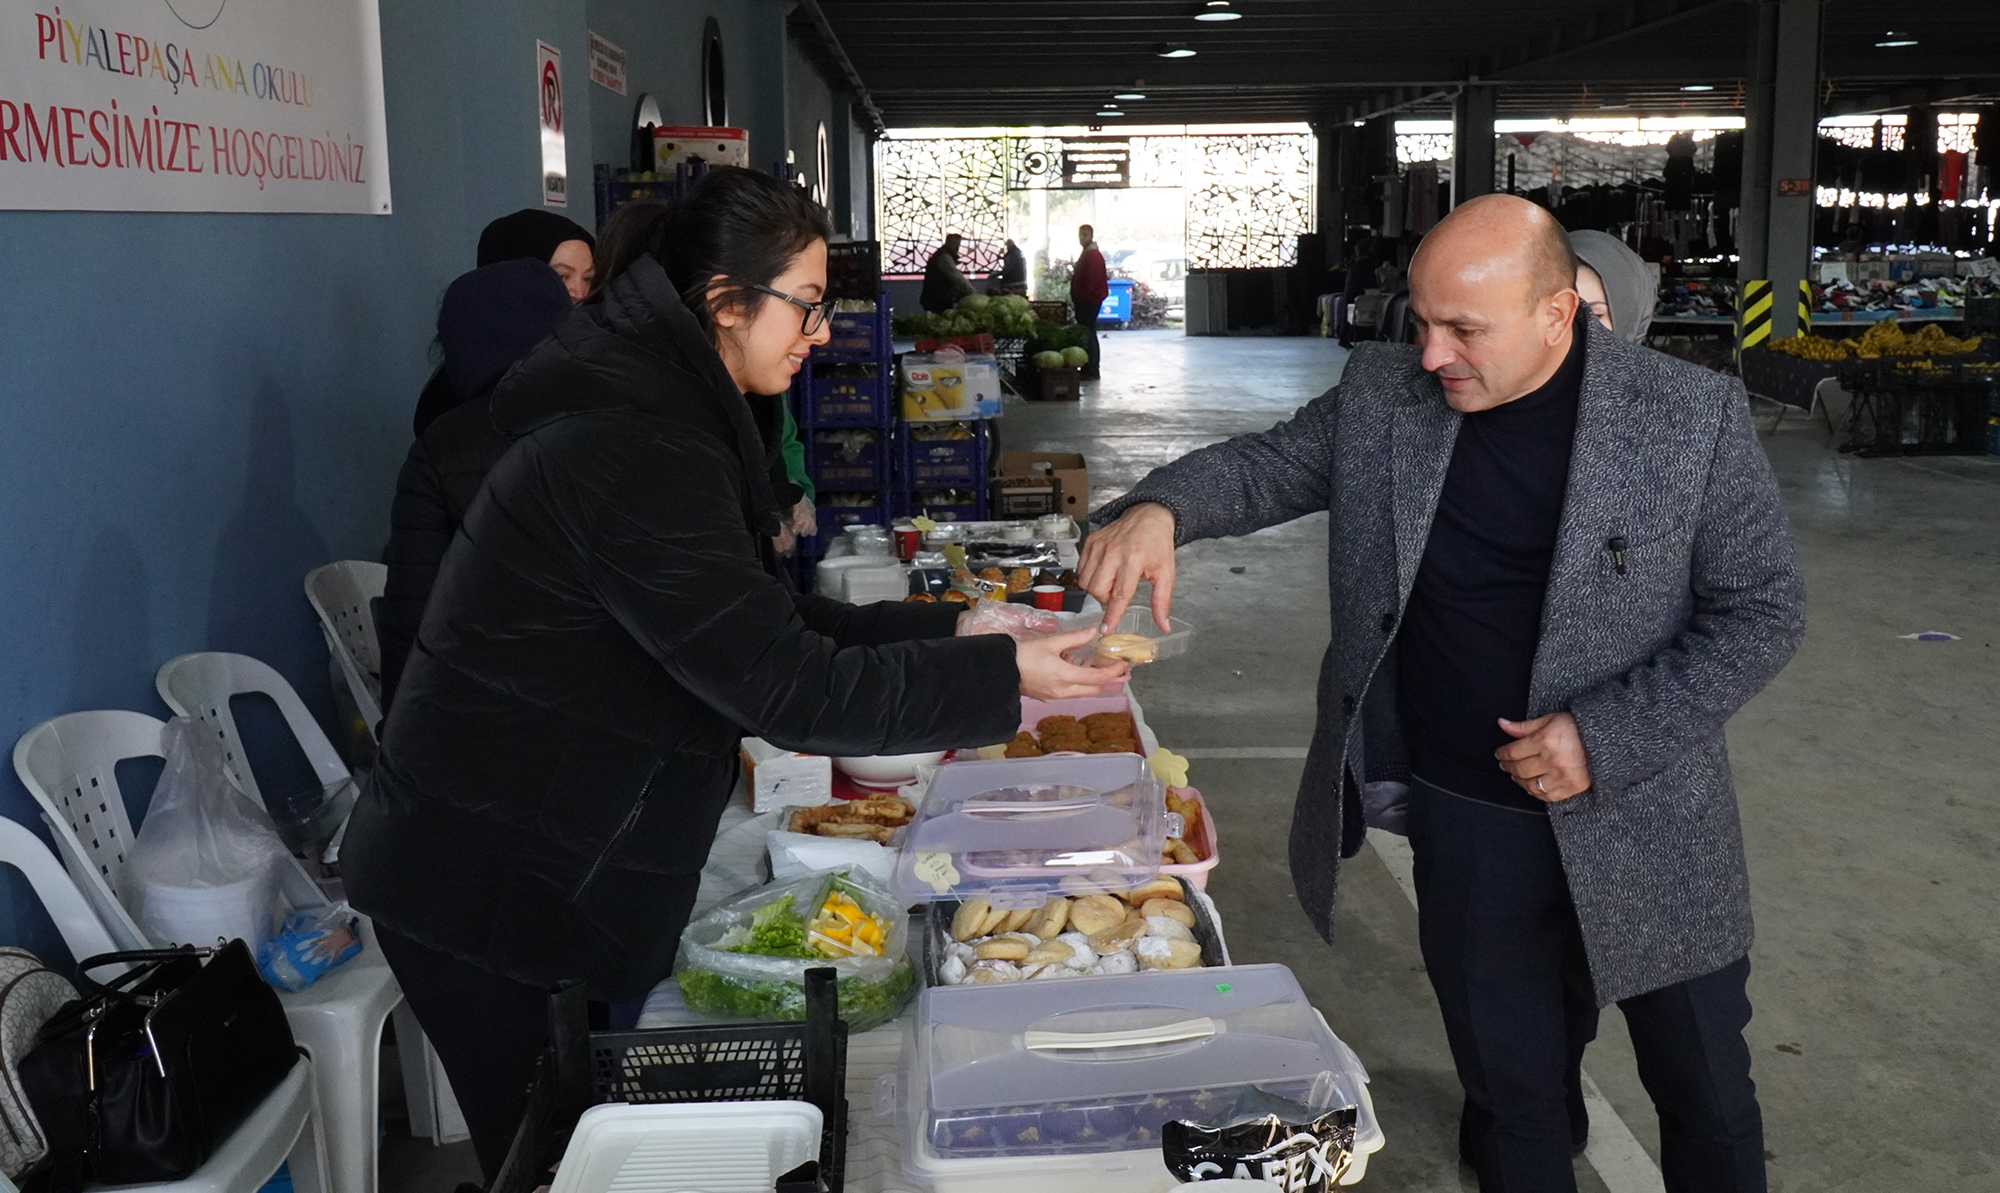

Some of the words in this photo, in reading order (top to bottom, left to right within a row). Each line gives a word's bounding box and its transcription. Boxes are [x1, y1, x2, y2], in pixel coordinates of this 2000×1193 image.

[35, 6, 198, 95] PİYALEPAŞA
[203, 53, 249, 96] ANA
[252, 62, 313, 107] OKULU
[208, 126, 366, 190] HOŞGELDİNİZ
